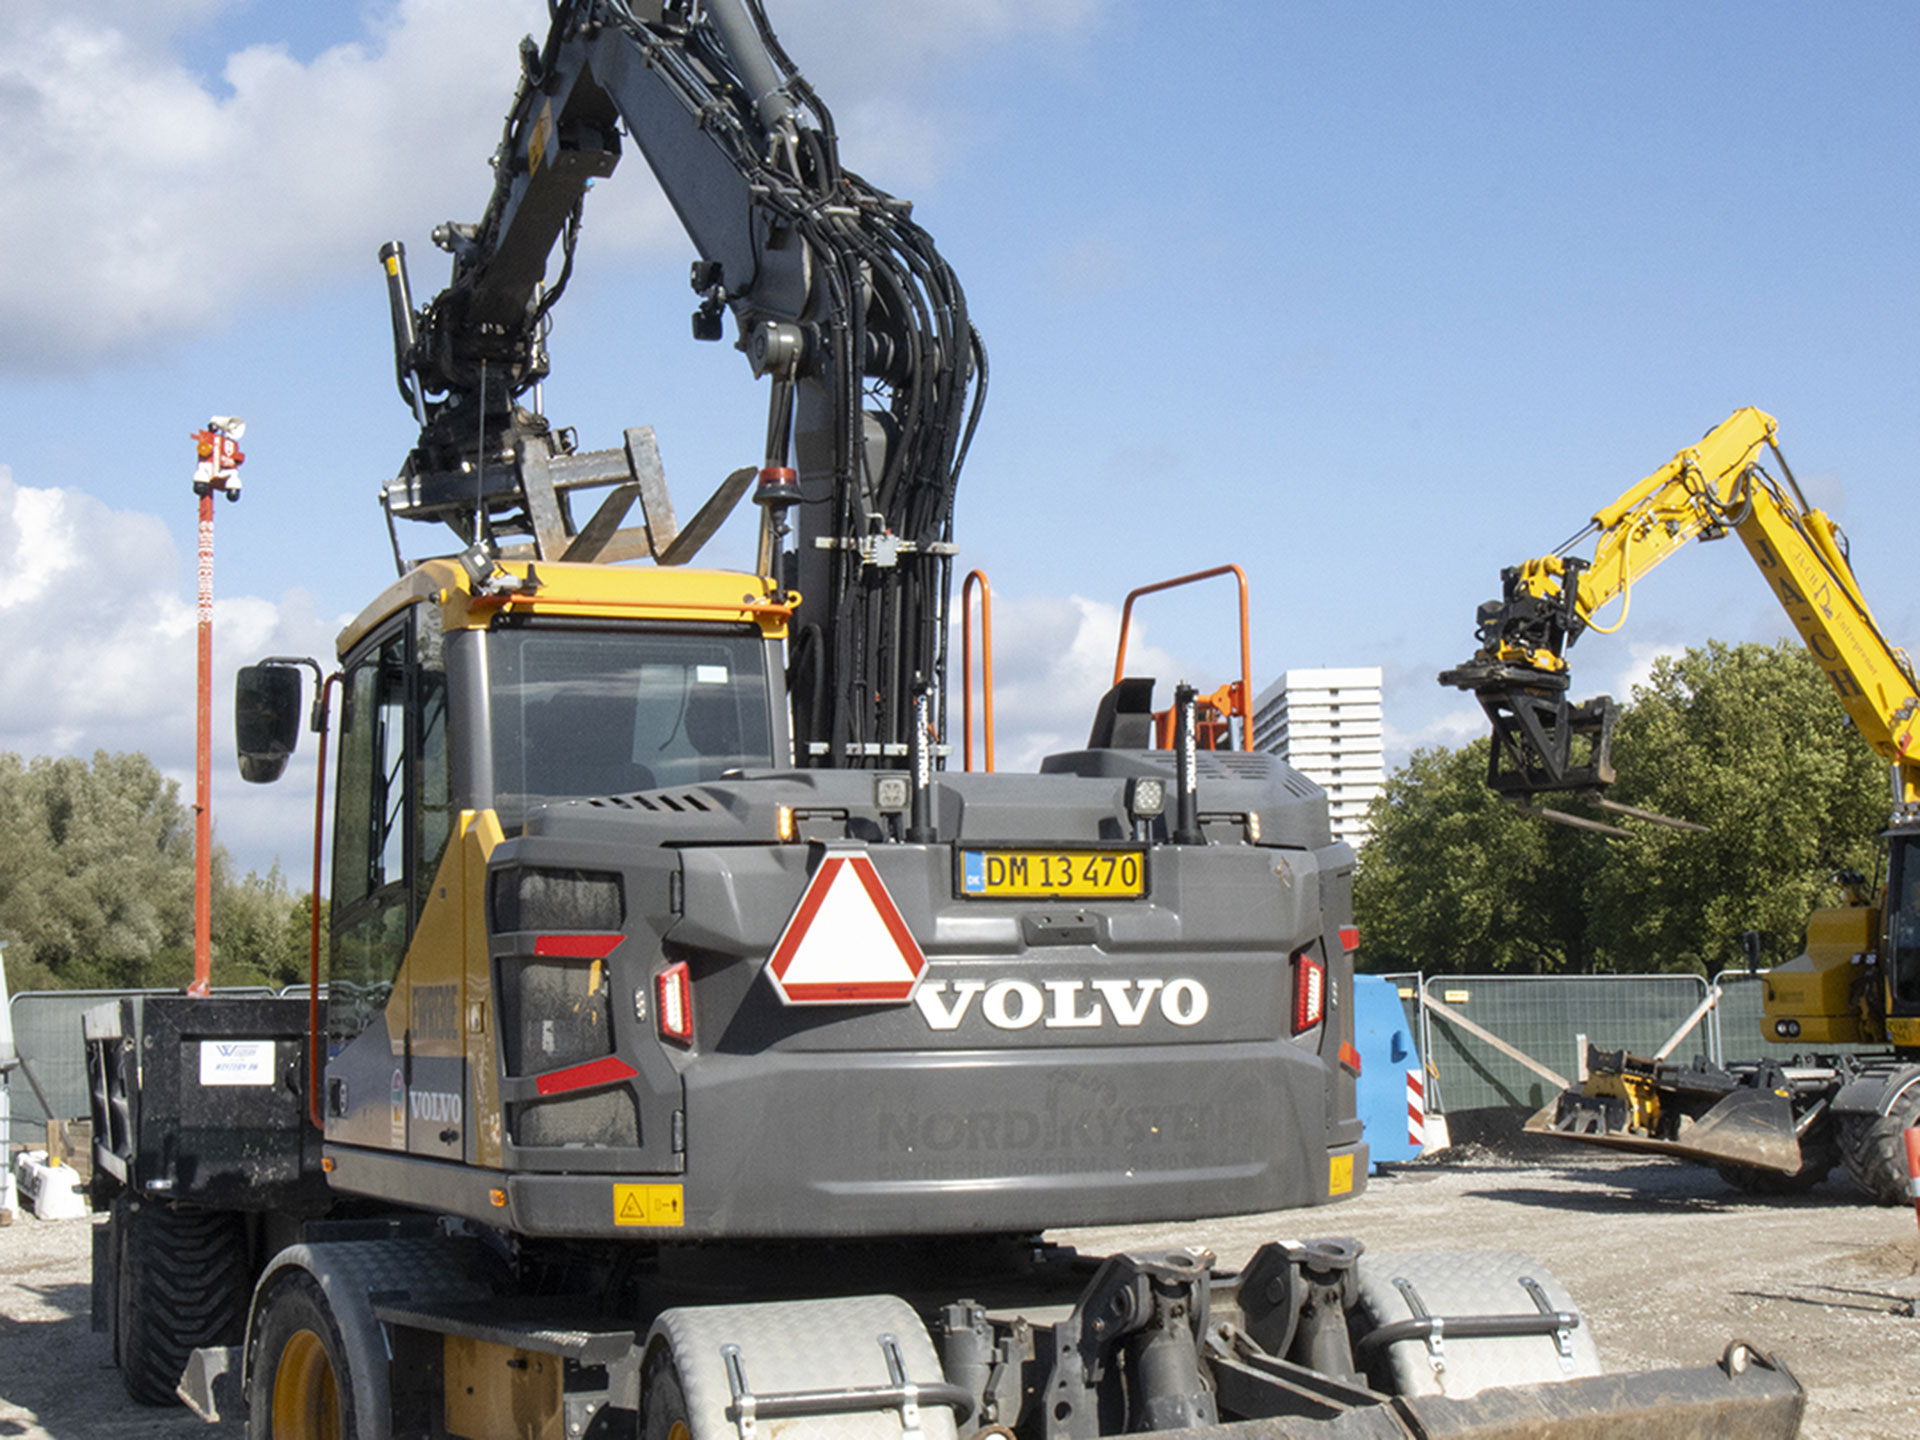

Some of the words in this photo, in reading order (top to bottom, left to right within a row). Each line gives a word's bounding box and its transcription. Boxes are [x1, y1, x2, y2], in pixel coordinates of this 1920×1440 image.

[967, 874, 981, 886] DK
[987, 856, 1028, 887] DM
[1040, 857, 1073, 887] 13
[1083, 856, 1138, 887] 470
[914, 978, 1208, 1030] VOLVO
[409, 1091, 462, 1124] VOLVO
